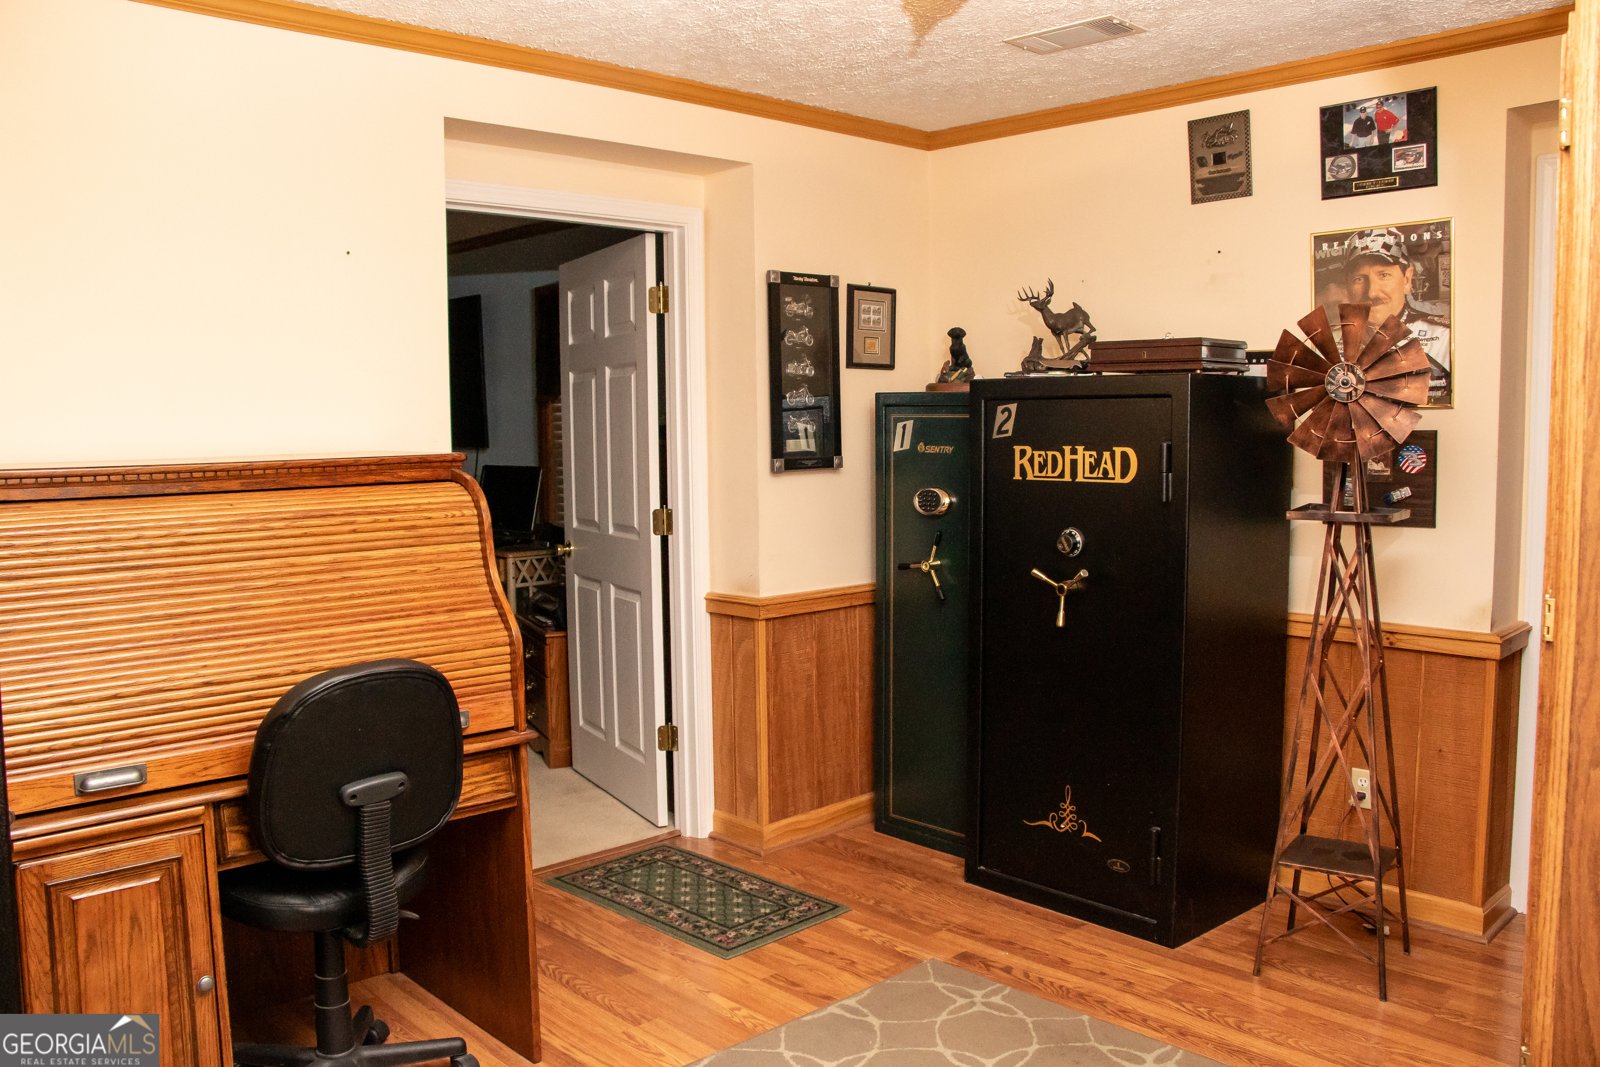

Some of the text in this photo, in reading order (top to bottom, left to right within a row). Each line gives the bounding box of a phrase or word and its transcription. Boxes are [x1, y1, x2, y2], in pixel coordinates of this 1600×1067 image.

[1322, 231, 1442, 250] REFLTIONS
[996, 406, 1012, 437] 2
[900, 423, 907, 449] 1
[925, 445, 954, 454] SENTRY
